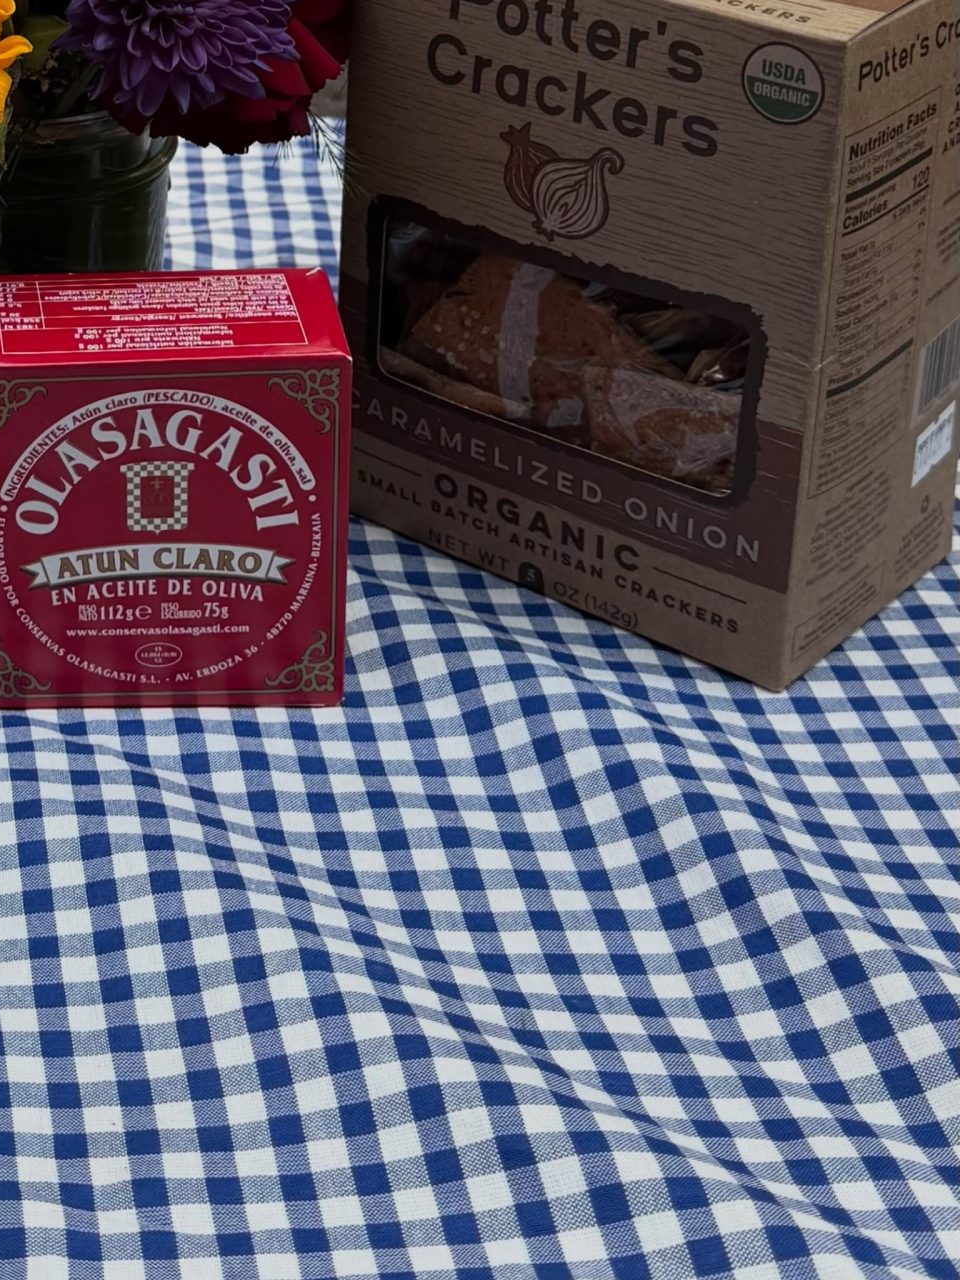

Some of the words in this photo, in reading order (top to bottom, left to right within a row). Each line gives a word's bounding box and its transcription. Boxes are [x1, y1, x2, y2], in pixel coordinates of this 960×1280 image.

[761, 59, 806, 86] USDA
[858, 33, 929, 92] Potter's
[427, 33, 718, 158] Crackers
[753, 80, 811, 109] ORGANIC
[849, 123, 904, 161] Nutrition
[906, 102, 937, 131] Facts
[843, 200, 888, 230] Calories
[911, 167, 930, 190] 120
[4, 424, 69, 498] INGREDIENTES:
[71, 406, 102, 426] Atún
[105, 397, 138, 411] claro
[221, 403, 258, 426] aceite
[259, 424, 274, 439] de
[274, 437, 296, 467] oliva,
[296, 467, 312, 485] sal
[15, 408, 299, 535] OLASAGASTI
[350, 388, 603, 505] CARAMELIZED
[624, 497, 760, 562] ONION
[357, 469, 421, 507] SMALL
[430, 499, 499, 537] BATCH
[509, 532, 604, 582] ARTISAN
[614, 574, 740, 635] CRACKERS
[433, 472, 641, 572] ORGANIC
[51, 587, 77, 607] EN
[87, 579, 158, 600] ACEITE
[168, 579, 192, 596] DE
[202, 580, 264, 602] OLIVA
[57, 549, 139, 579] ATUN
[153, 548, 262, 574] CLARO
[427, 527, 468, 556] NET
[479, 547, 510, 572] WT
[525, 569, 536, 585] 5
[553, 581, 578, 605] OZ
[583, 588, 638, 629] (142g)
[4, 585, 19, 607] POR
[16, 608, 66, 656] CONSERVAS
[66, 654, 136, 682] OLASAGASTI
[140, 675, 161, 684] S.L.
[175, 672, 193, 682] AV.
[196, 654, 242, 678] ERDOZA
[244, 645, 258, 658] 36
[266, 612, 292, 640] 48270
[66, 623, 250, 637] www.conservasolasagasti.com
[204, 603, 229, 619] 75g
